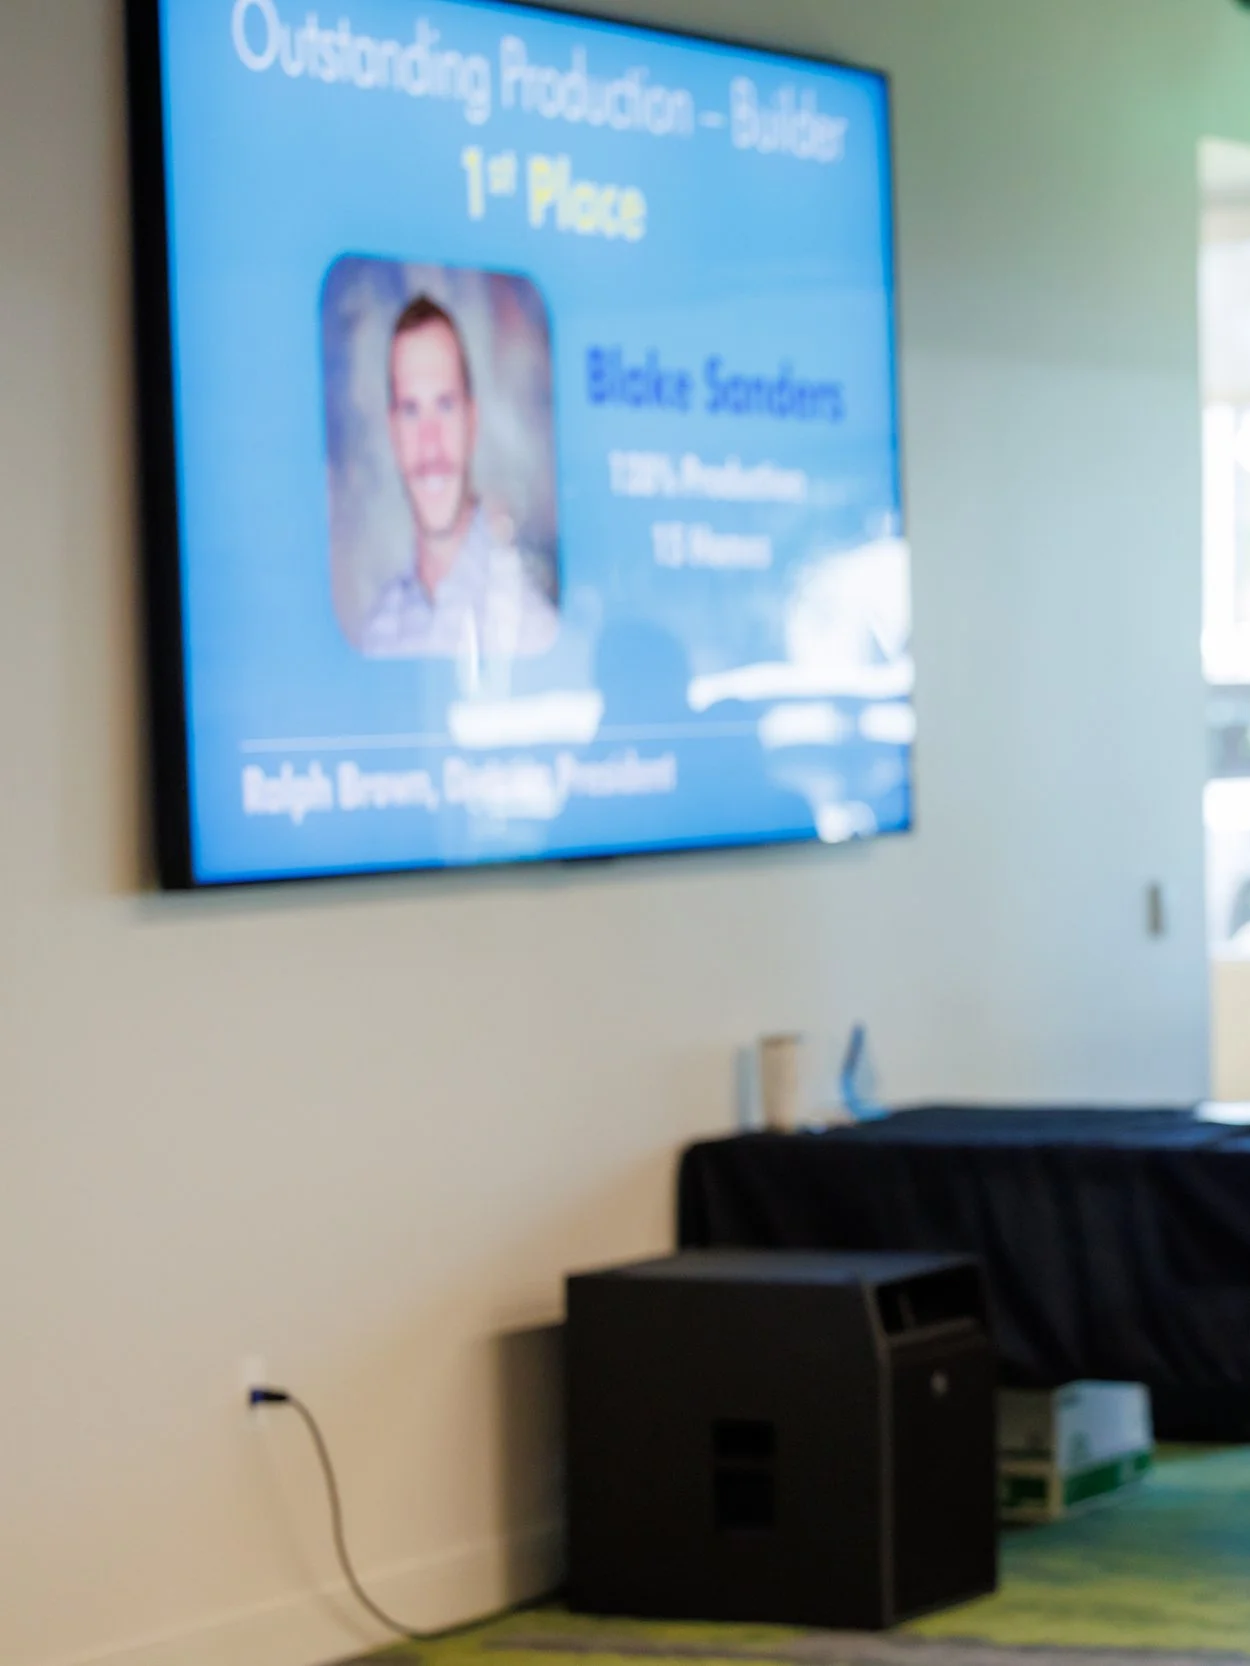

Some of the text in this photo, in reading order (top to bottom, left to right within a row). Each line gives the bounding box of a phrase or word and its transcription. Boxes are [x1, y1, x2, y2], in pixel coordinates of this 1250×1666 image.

[232, 0, 491, 125] Outstanding
[502, 36, 694, 136] Production
[730, 76, 849, 162] Builder
[462, 146, 648, 241] 1st Place
[586, 346, 846, 424] Blake Sanders
